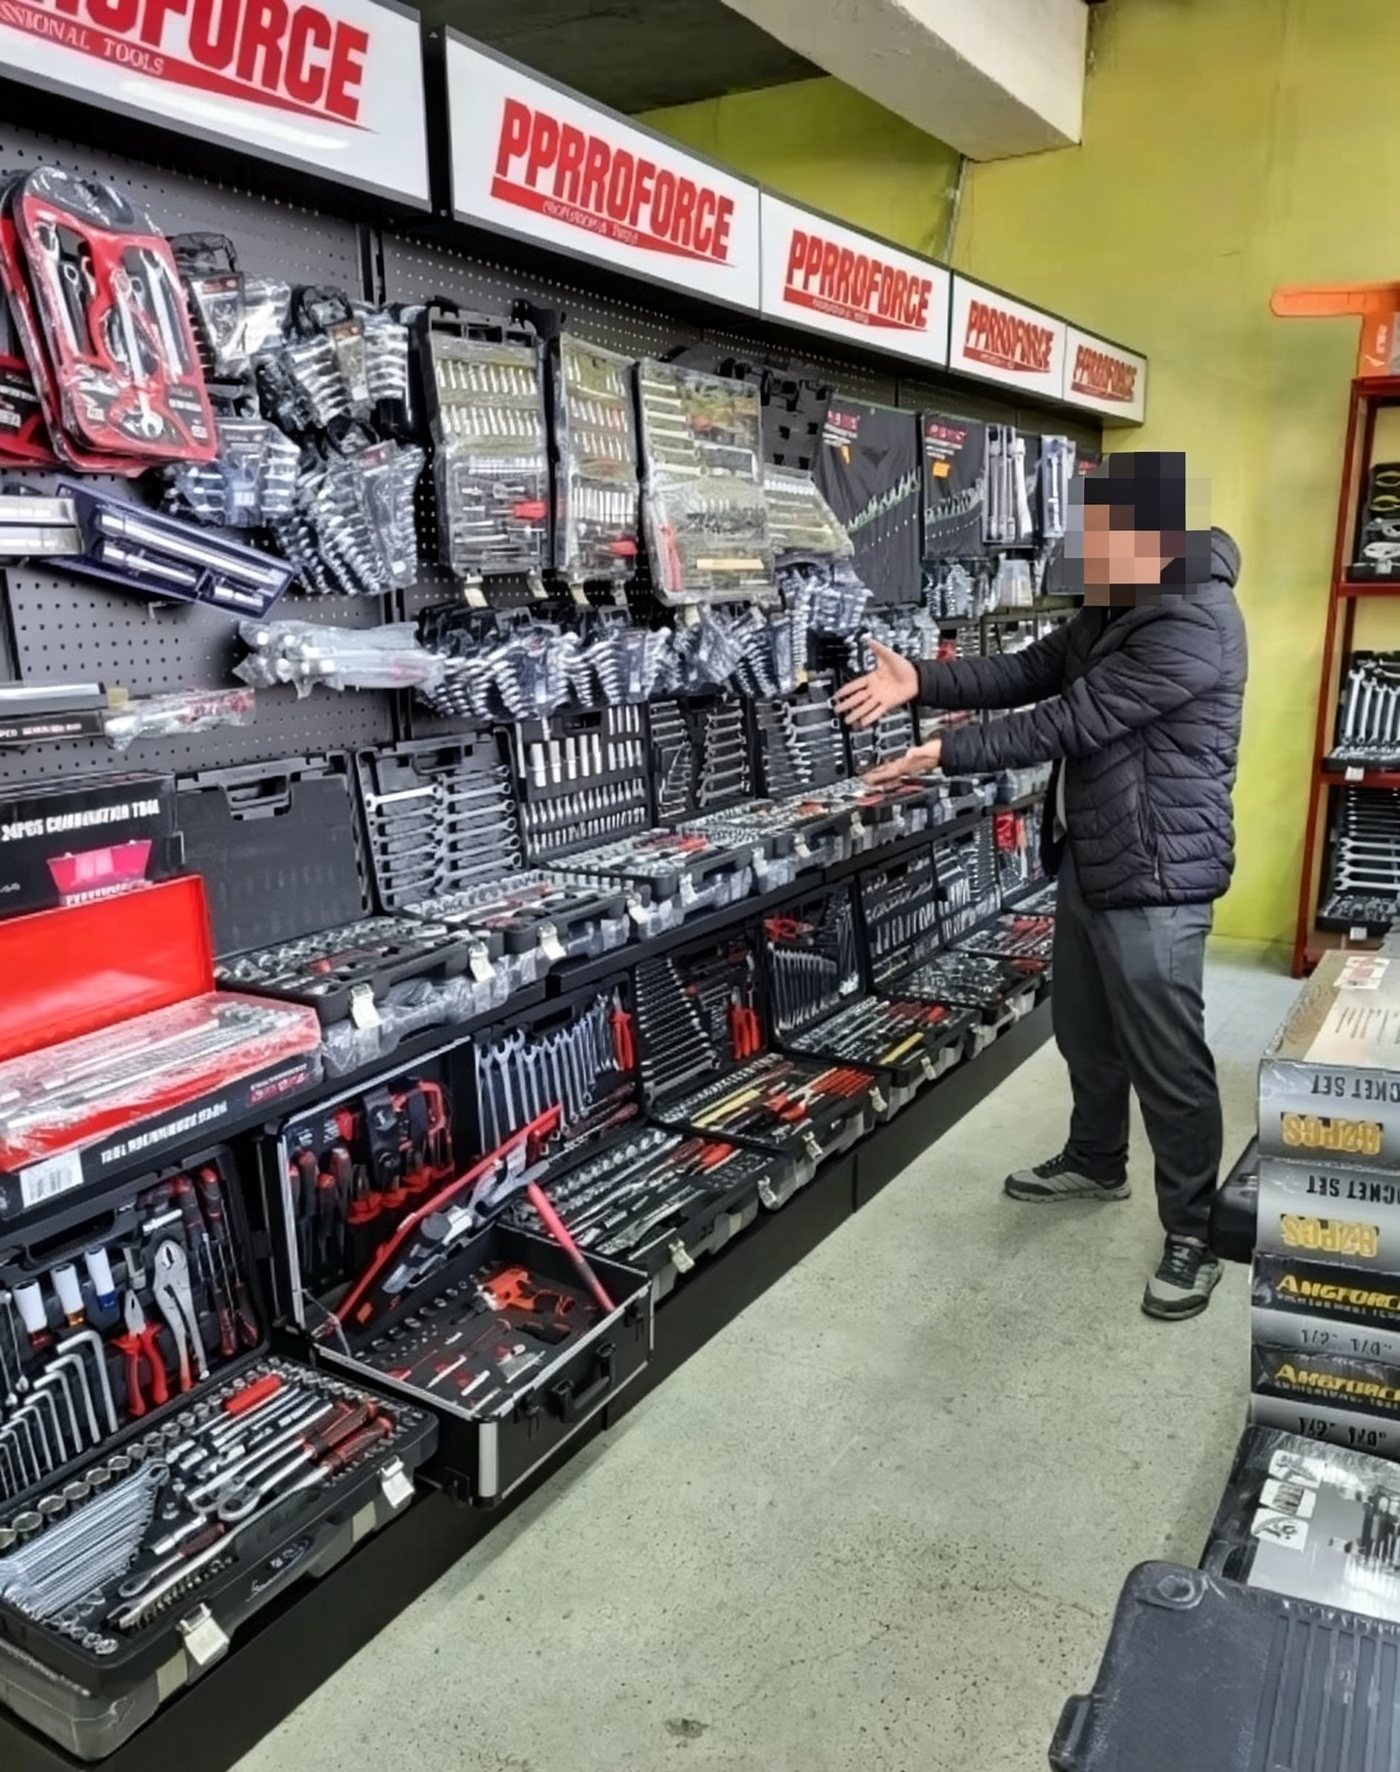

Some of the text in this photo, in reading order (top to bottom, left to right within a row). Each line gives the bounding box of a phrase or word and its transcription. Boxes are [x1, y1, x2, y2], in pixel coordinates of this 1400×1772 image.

[103, 38, 165, 76] TOOLS
[496, 97, 734, 261] PPRROFORCE
[786, 229, 933, 328] PPRROFORCE
[1310, 1075, 1346, 1098] SET
[1306, 1175, 1341, 1198] SET
